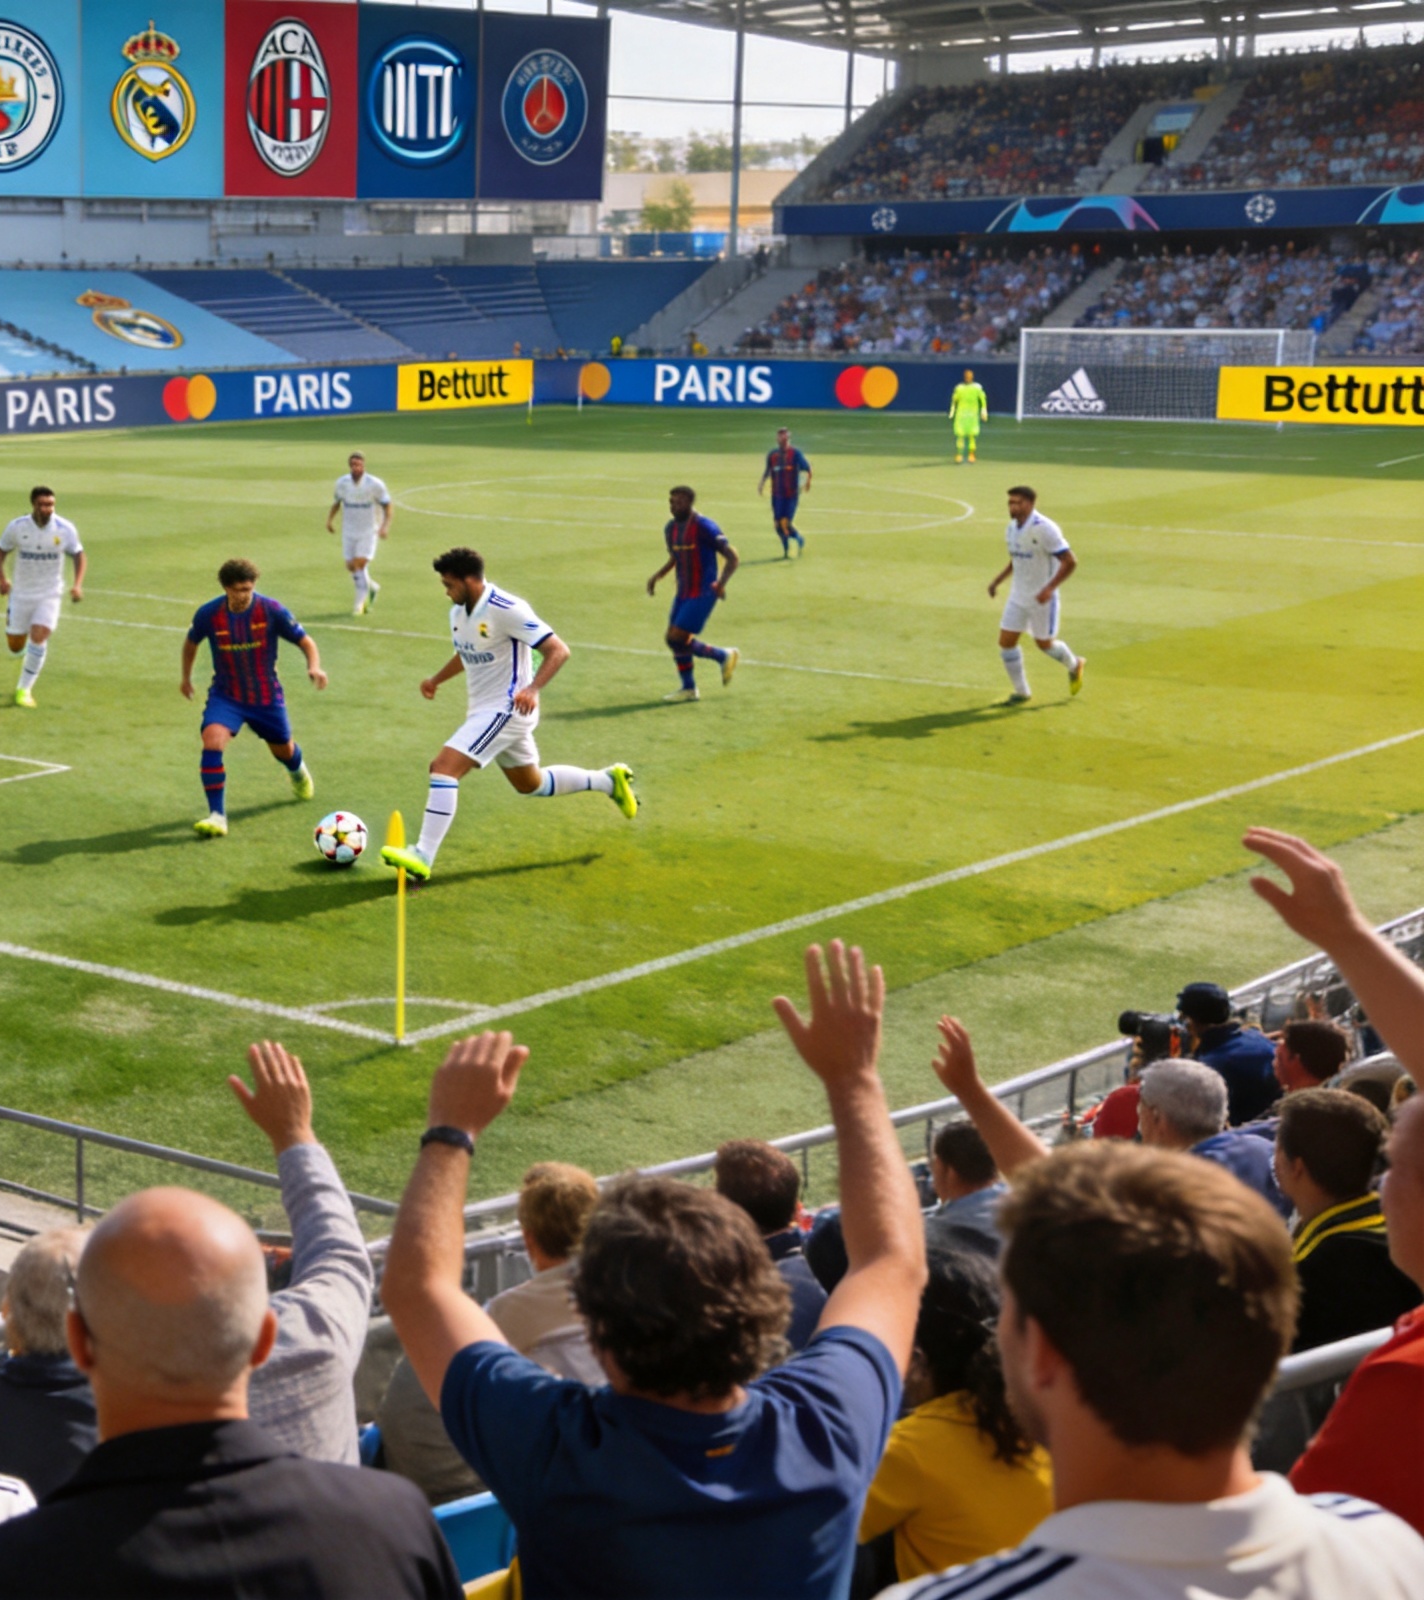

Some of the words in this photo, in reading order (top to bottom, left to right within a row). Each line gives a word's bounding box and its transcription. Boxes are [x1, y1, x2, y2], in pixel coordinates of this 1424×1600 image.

[254, 372, 351, 414] PARIS
[418, 365, 510, 402] Bettutt
[655, 364, 772, 402] PARIS
[1264, 374, 1424, 415] Bettutt
[6, 385, 116, 428] PARIS
